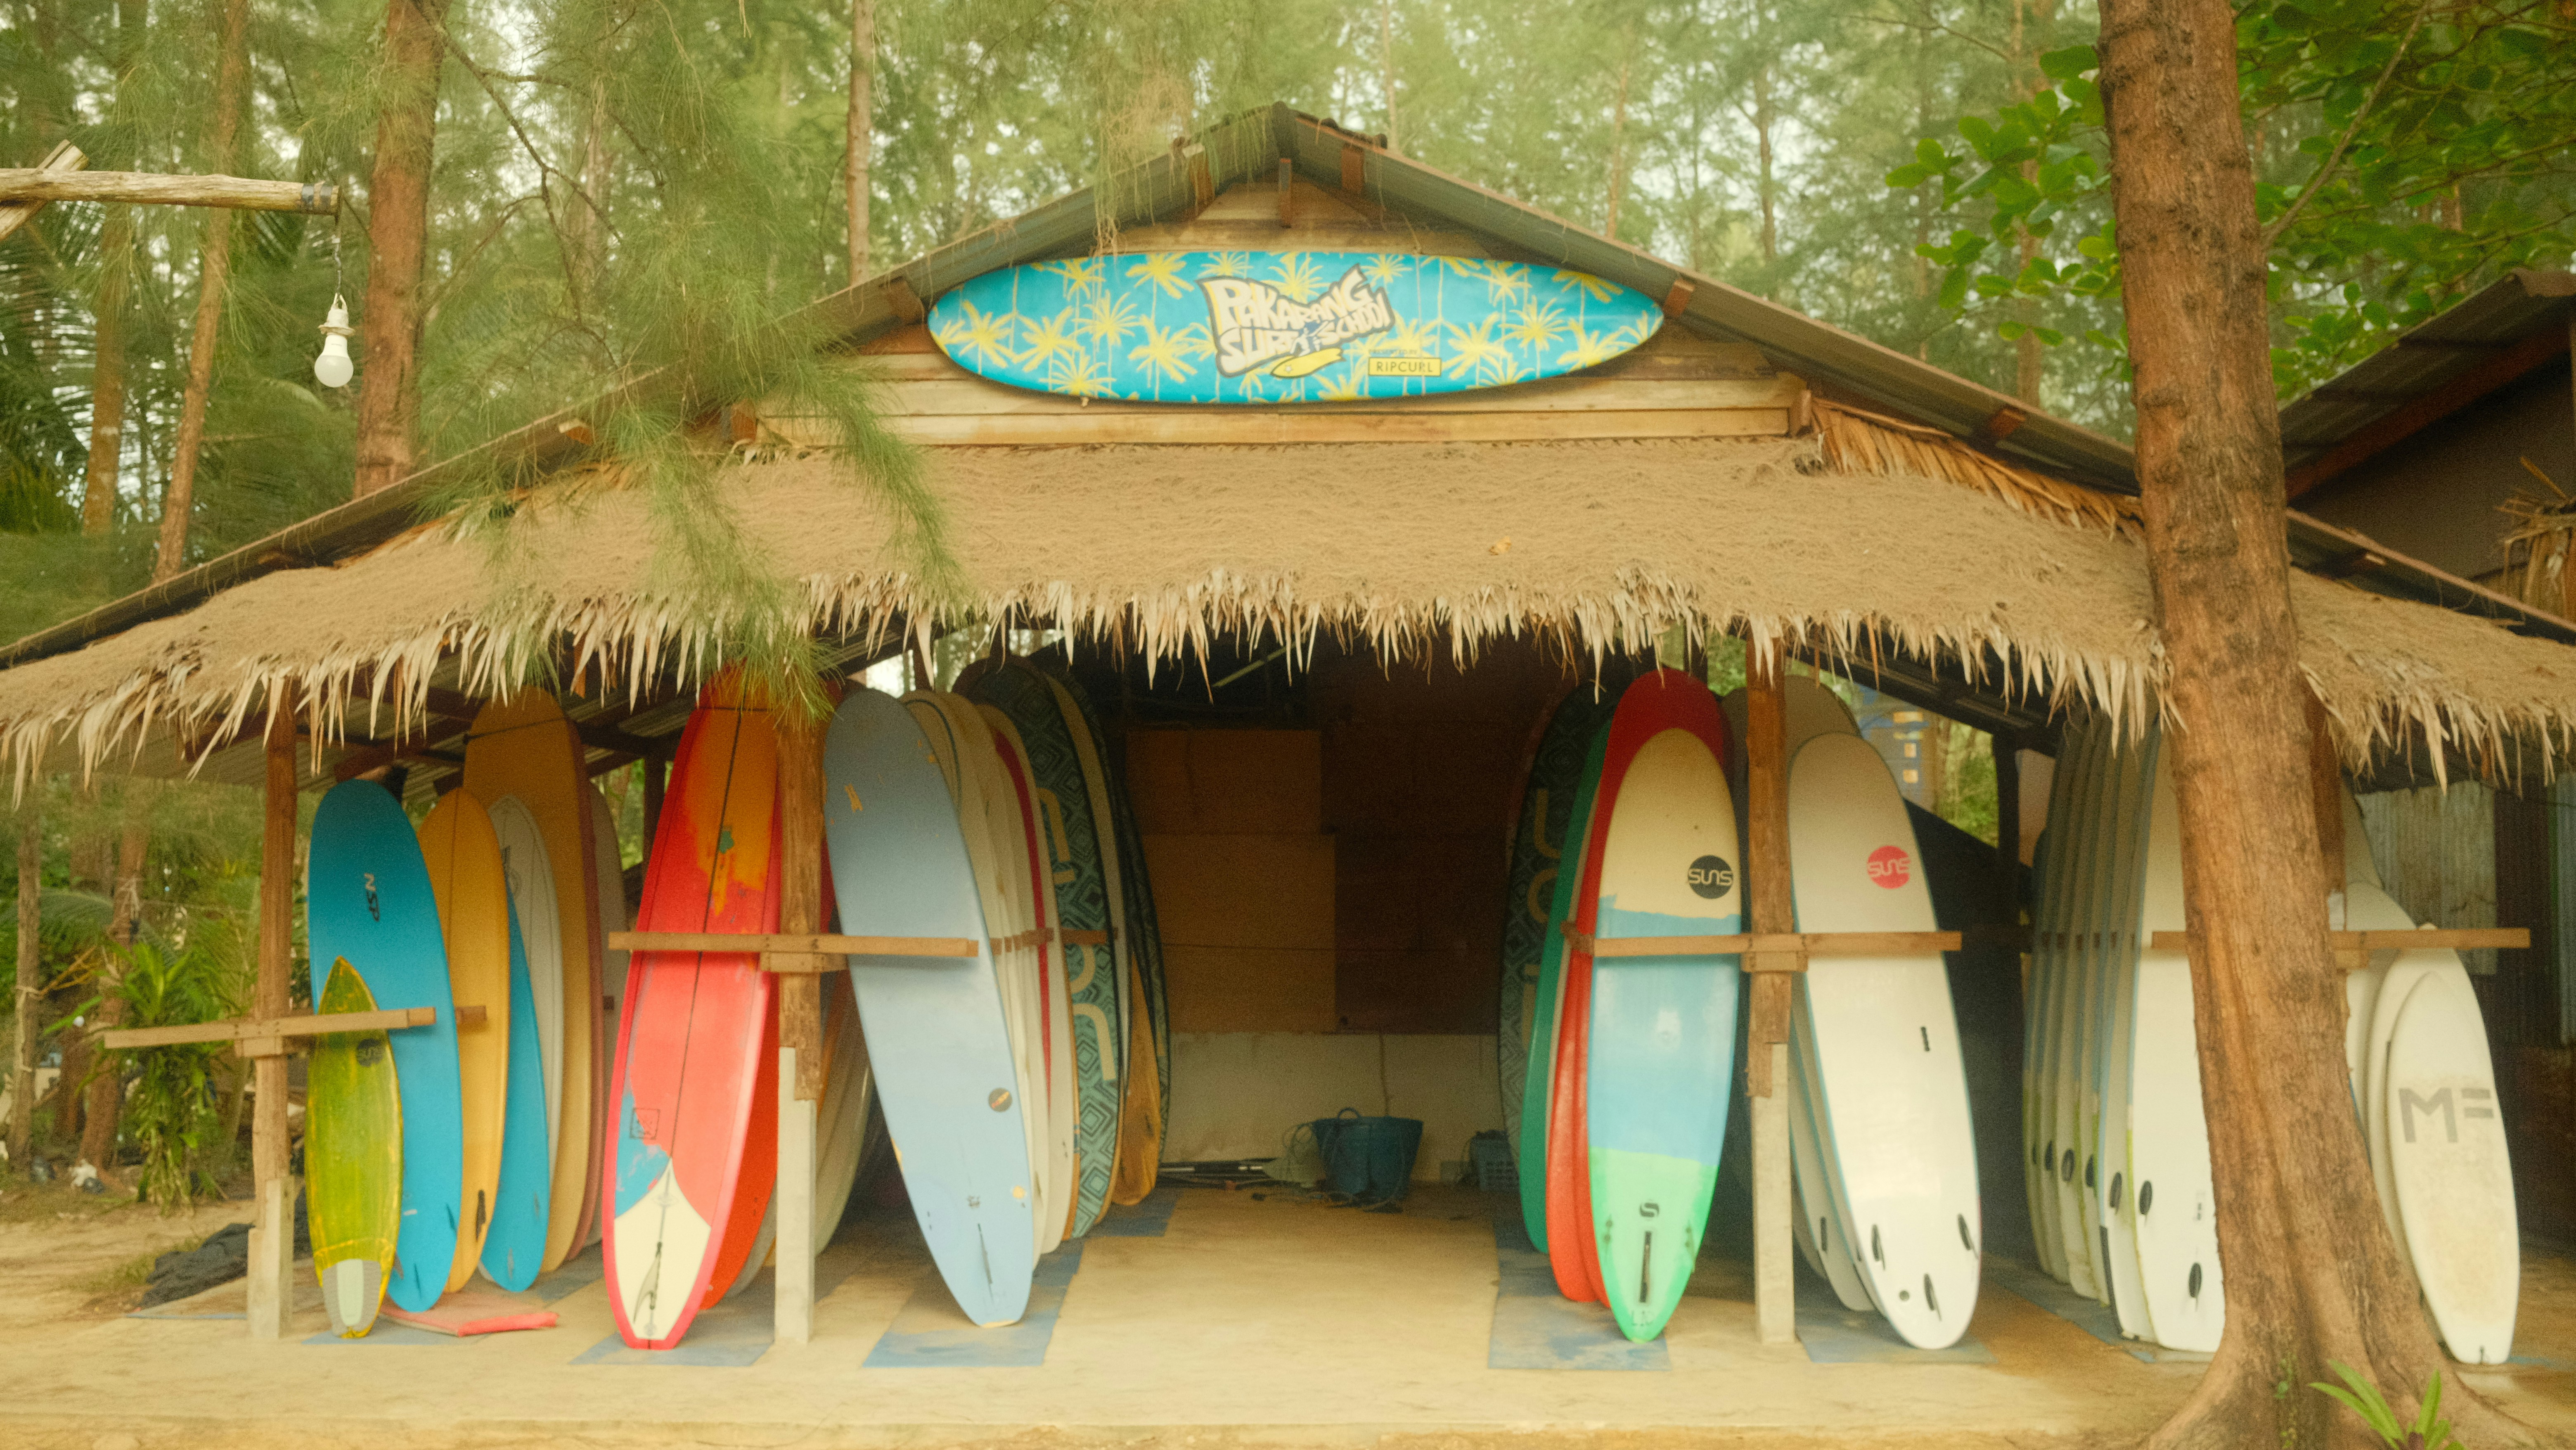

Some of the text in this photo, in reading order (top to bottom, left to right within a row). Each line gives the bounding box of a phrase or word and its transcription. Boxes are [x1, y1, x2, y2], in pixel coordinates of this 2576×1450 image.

[1202, 269, 1374, 335] PAKARANG
[1220, 292, 1391, 373] SURF SCHOOL
[1377, 361, 1433, 372] RIPCURL
